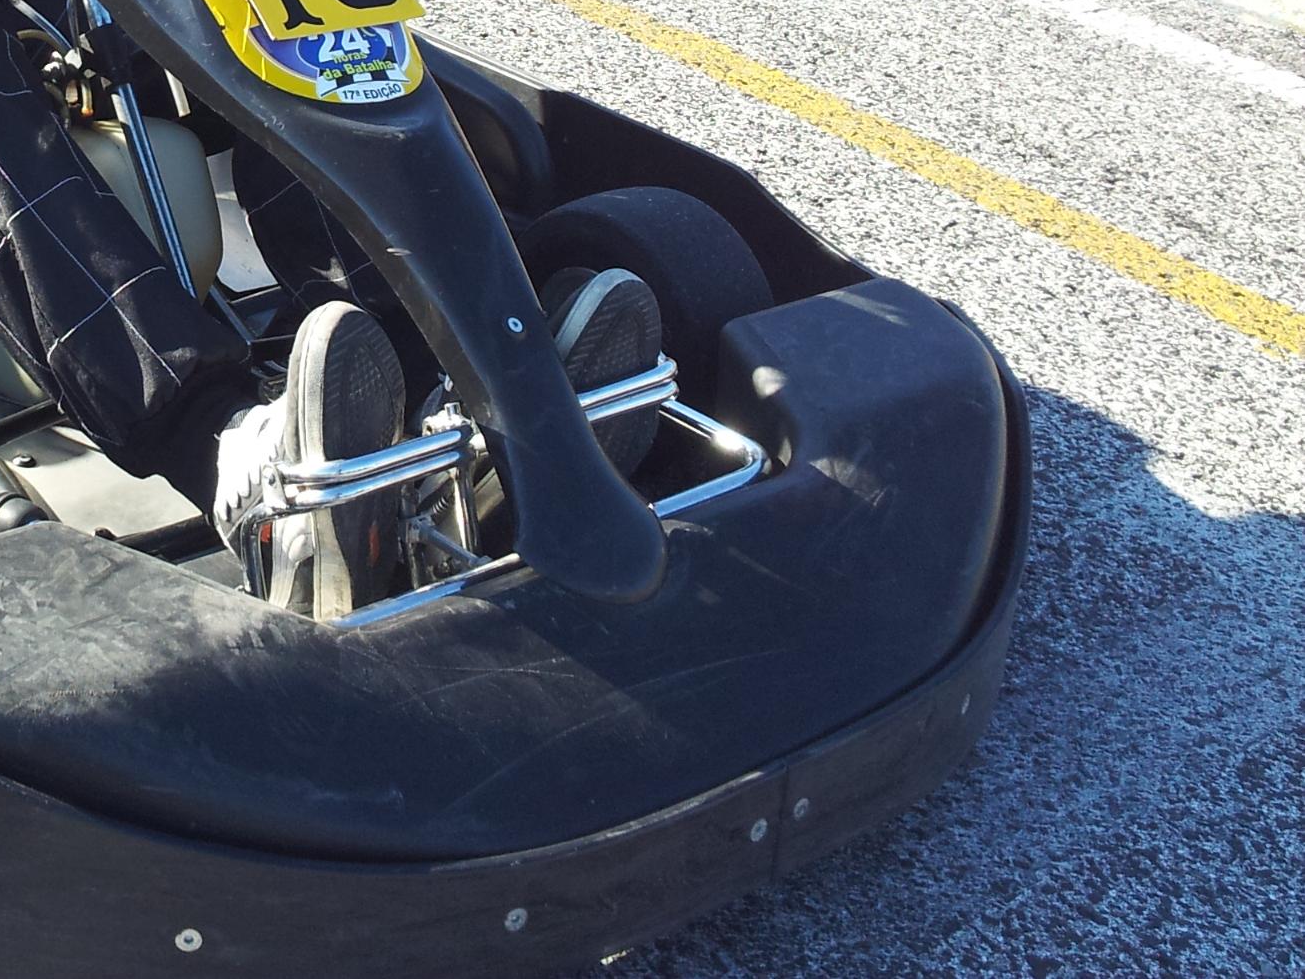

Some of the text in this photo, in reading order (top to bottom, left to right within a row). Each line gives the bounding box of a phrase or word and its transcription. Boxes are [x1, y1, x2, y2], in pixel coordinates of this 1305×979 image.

[318, 28, 371, 63] 24
[323, 59, 394, 81] da Batalha
[363, 83, 402, 100] EDIÇÃO
